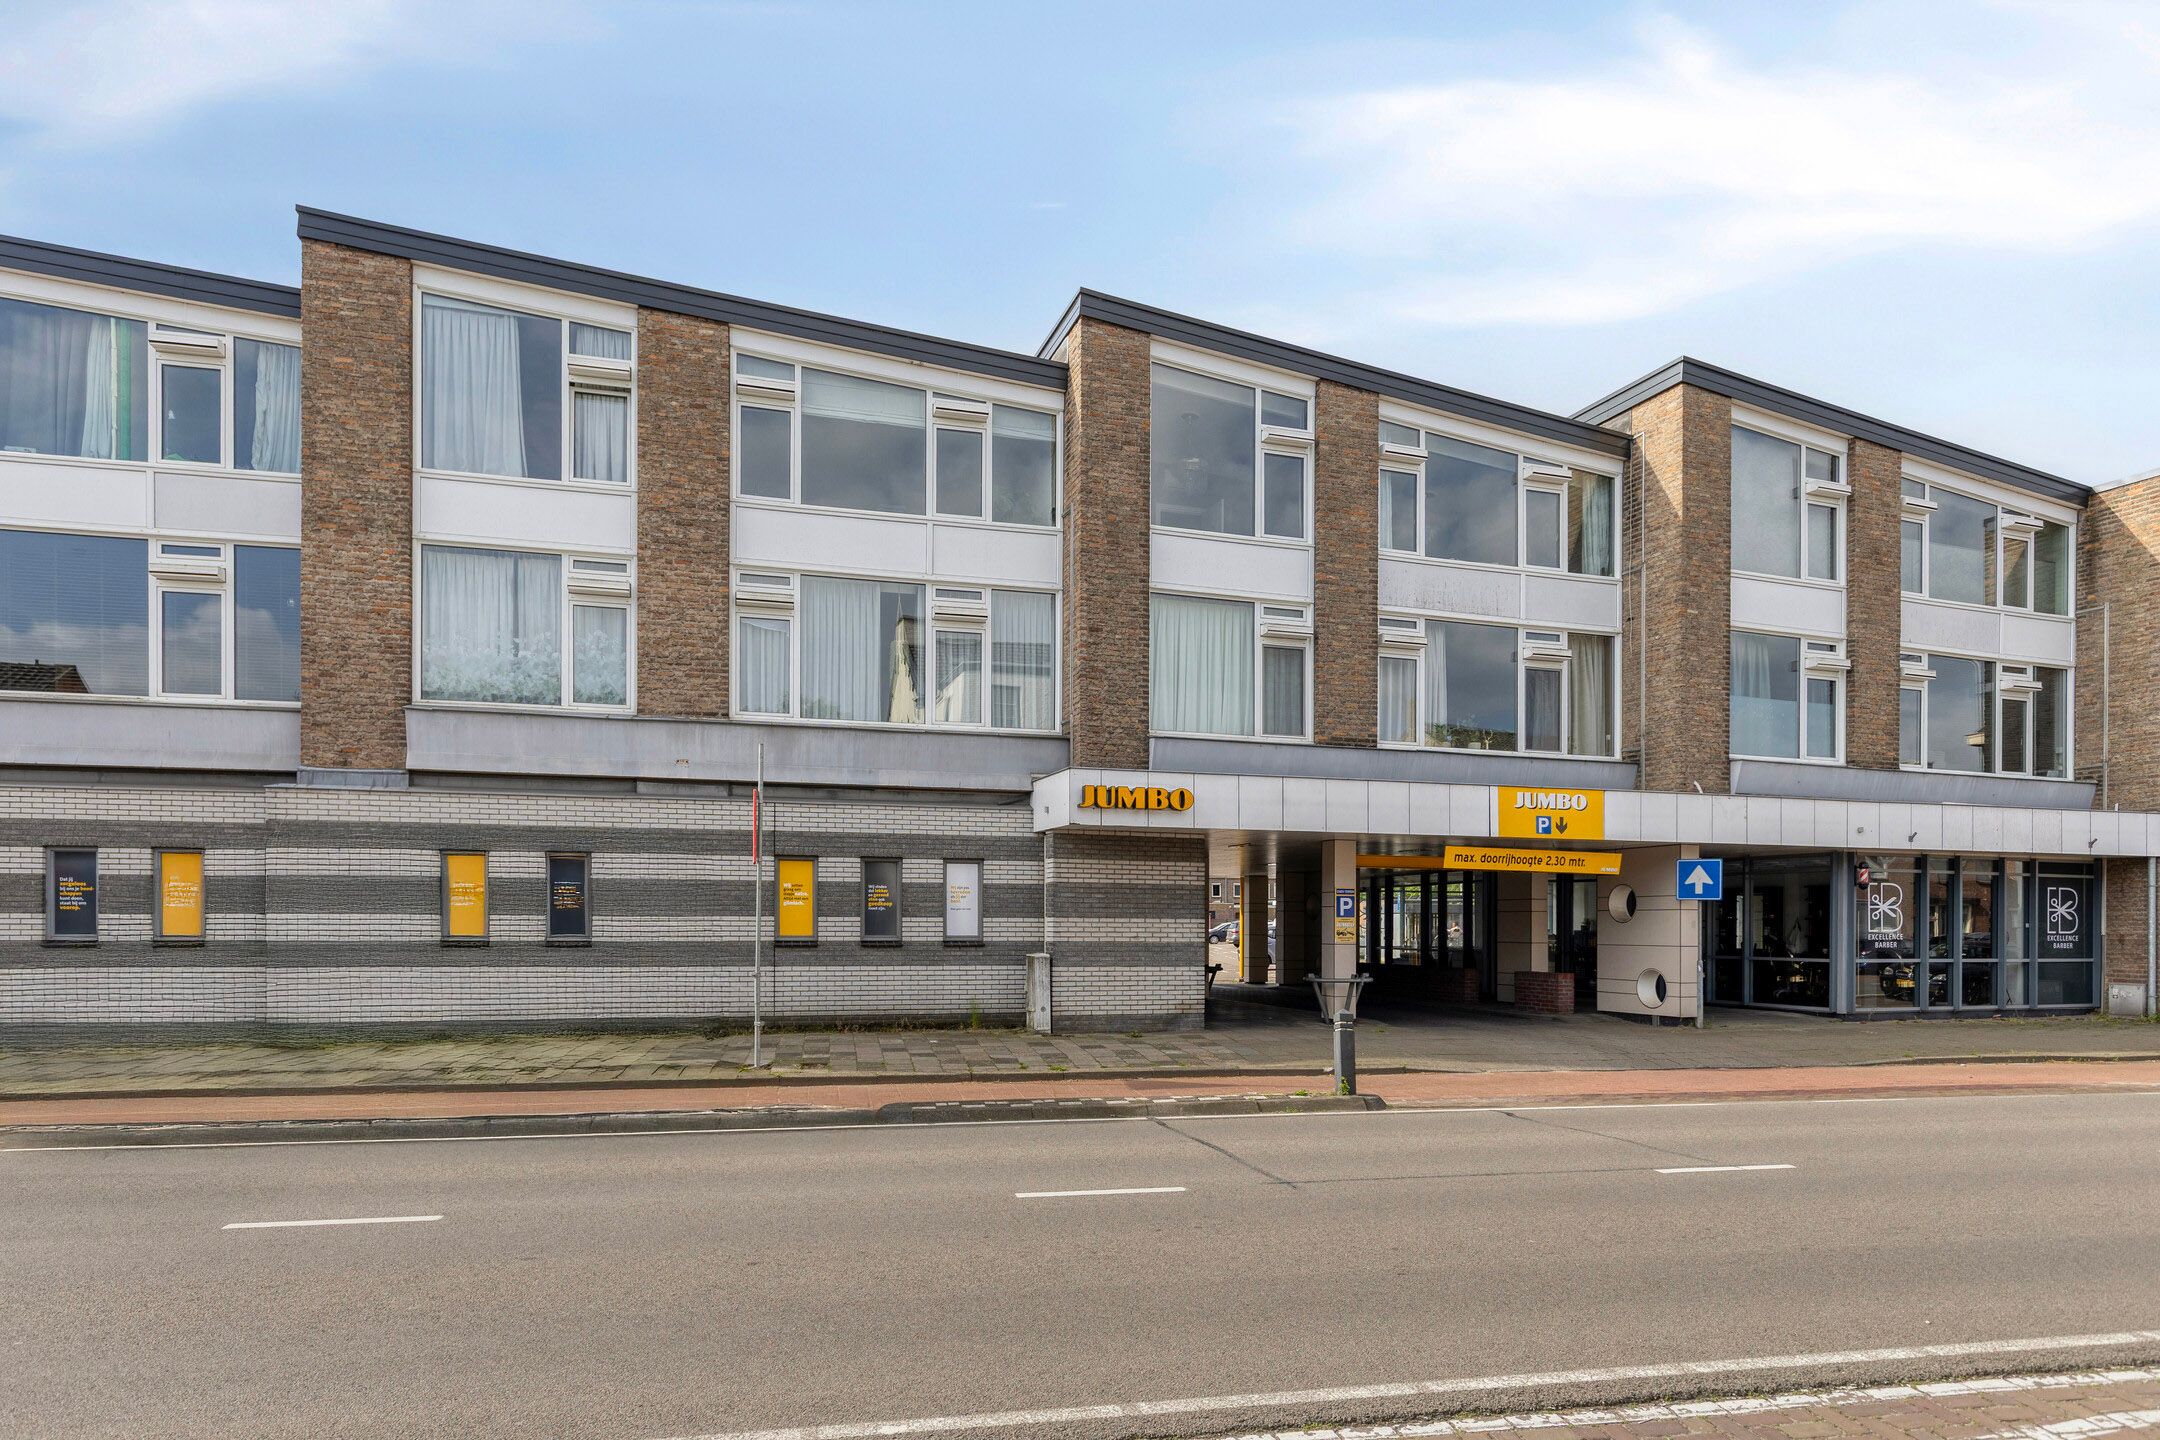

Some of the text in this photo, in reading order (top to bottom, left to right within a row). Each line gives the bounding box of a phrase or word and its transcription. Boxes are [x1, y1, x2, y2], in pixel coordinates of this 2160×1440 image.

[1077, 784, 1195, 811] JUMBO
[1514, 791, 1588, 811] JUMBO
[1538, 817, 1550, 833] P
[1454, 853, 1477, 863] max.
[1480, 853, 1543, 867] doorrijhoogte
[1568, 857, 1586, 867] mtr.
[1340, 897, 1353, 917] P
[1867, 933, 1904, 941] EXCELLENCE
[1874, 941, 1898, 949] BARBER
